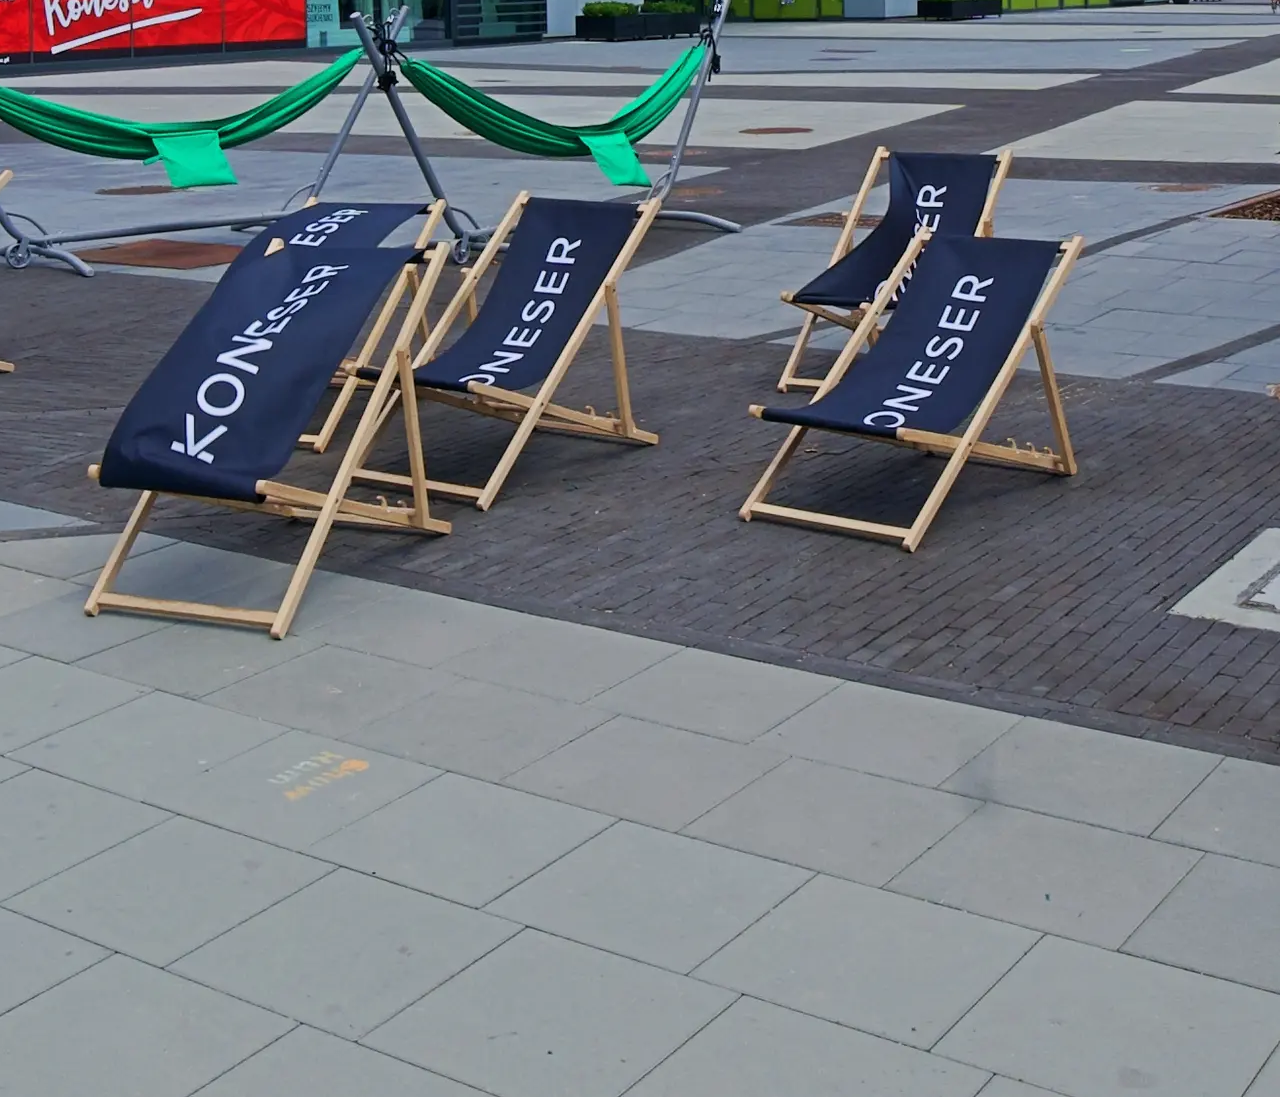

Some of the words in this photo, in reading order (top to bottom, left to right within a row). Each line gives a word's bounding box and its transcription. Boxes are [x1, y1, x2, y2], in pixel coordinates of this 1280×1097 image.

[289, 207, 368, 248] ESER
[170, 265, 349, 464] KONESER
[863, 274, 994, 428] ONESER
